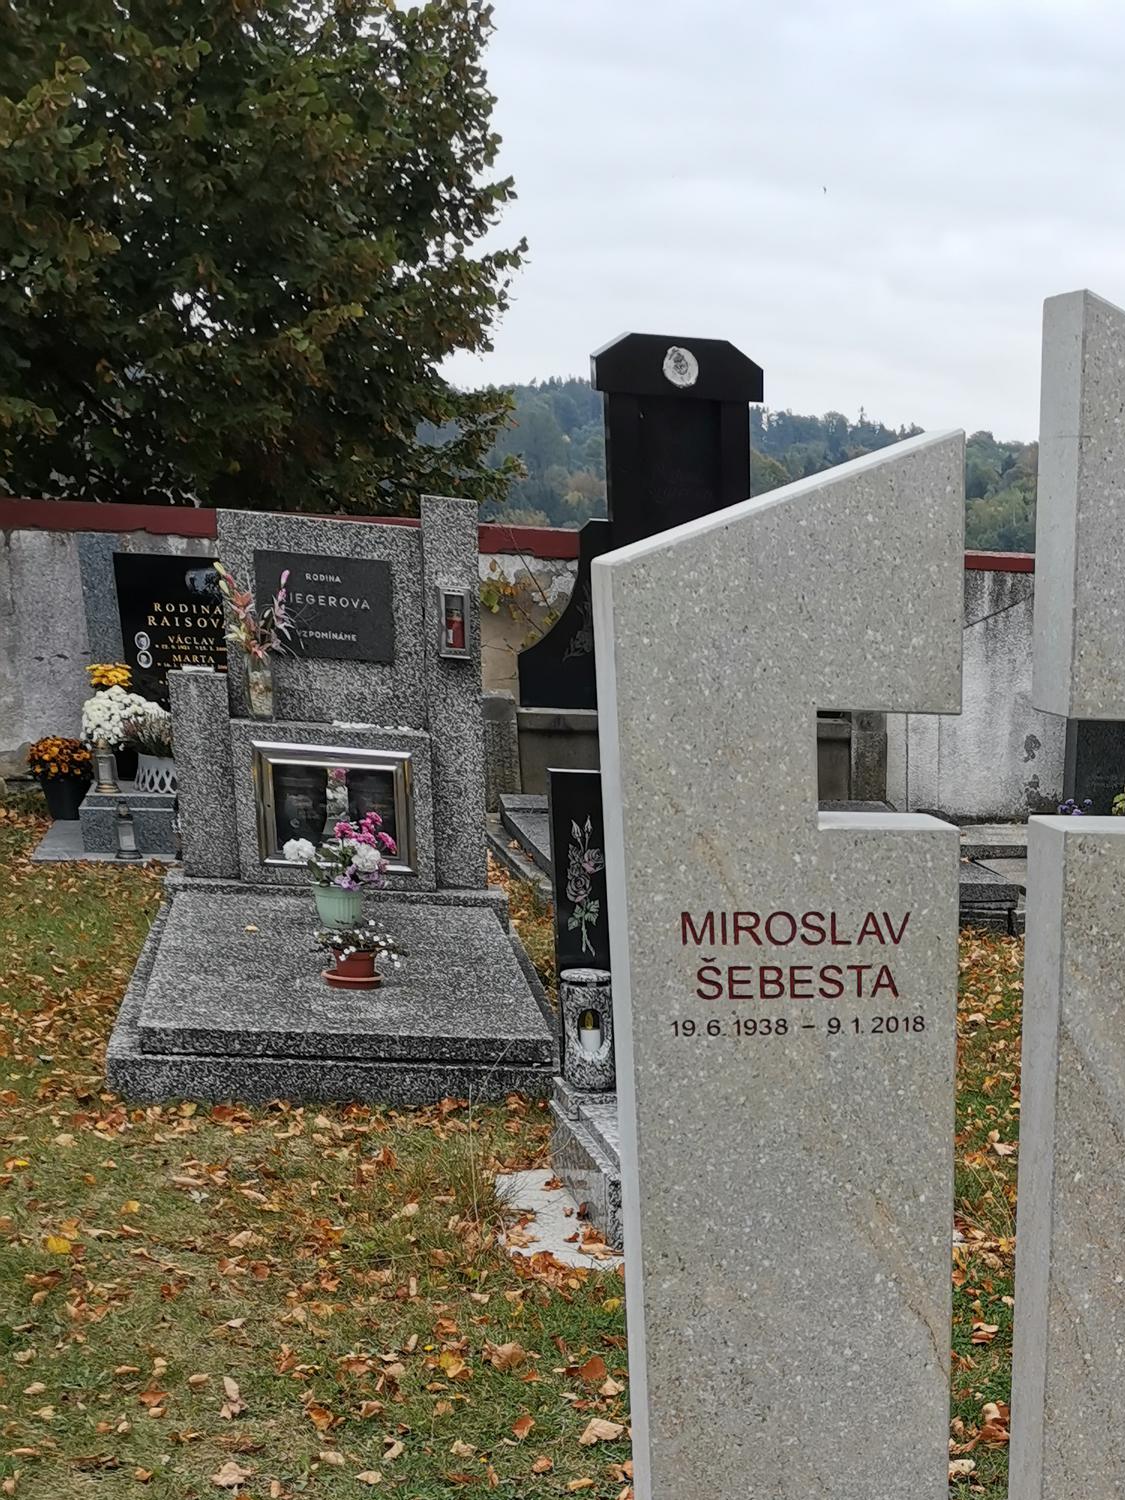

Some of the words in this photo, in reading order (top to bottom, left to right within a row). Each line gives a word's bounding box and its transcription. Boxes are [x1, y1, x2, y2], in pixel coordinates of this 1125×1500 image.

[305, 573, 342, 583] RODINA
[280, 591, 370, 610] IEGEROVA
[154, 603, 222, 615] RODINA
[168, 634, 215, 646] VÁCLAV
[172, 654, 215, 664] MARTA
[681, 911, 911, 946] MIROSLAV
[696, 957, 900, 1000] ŠEBESTA
